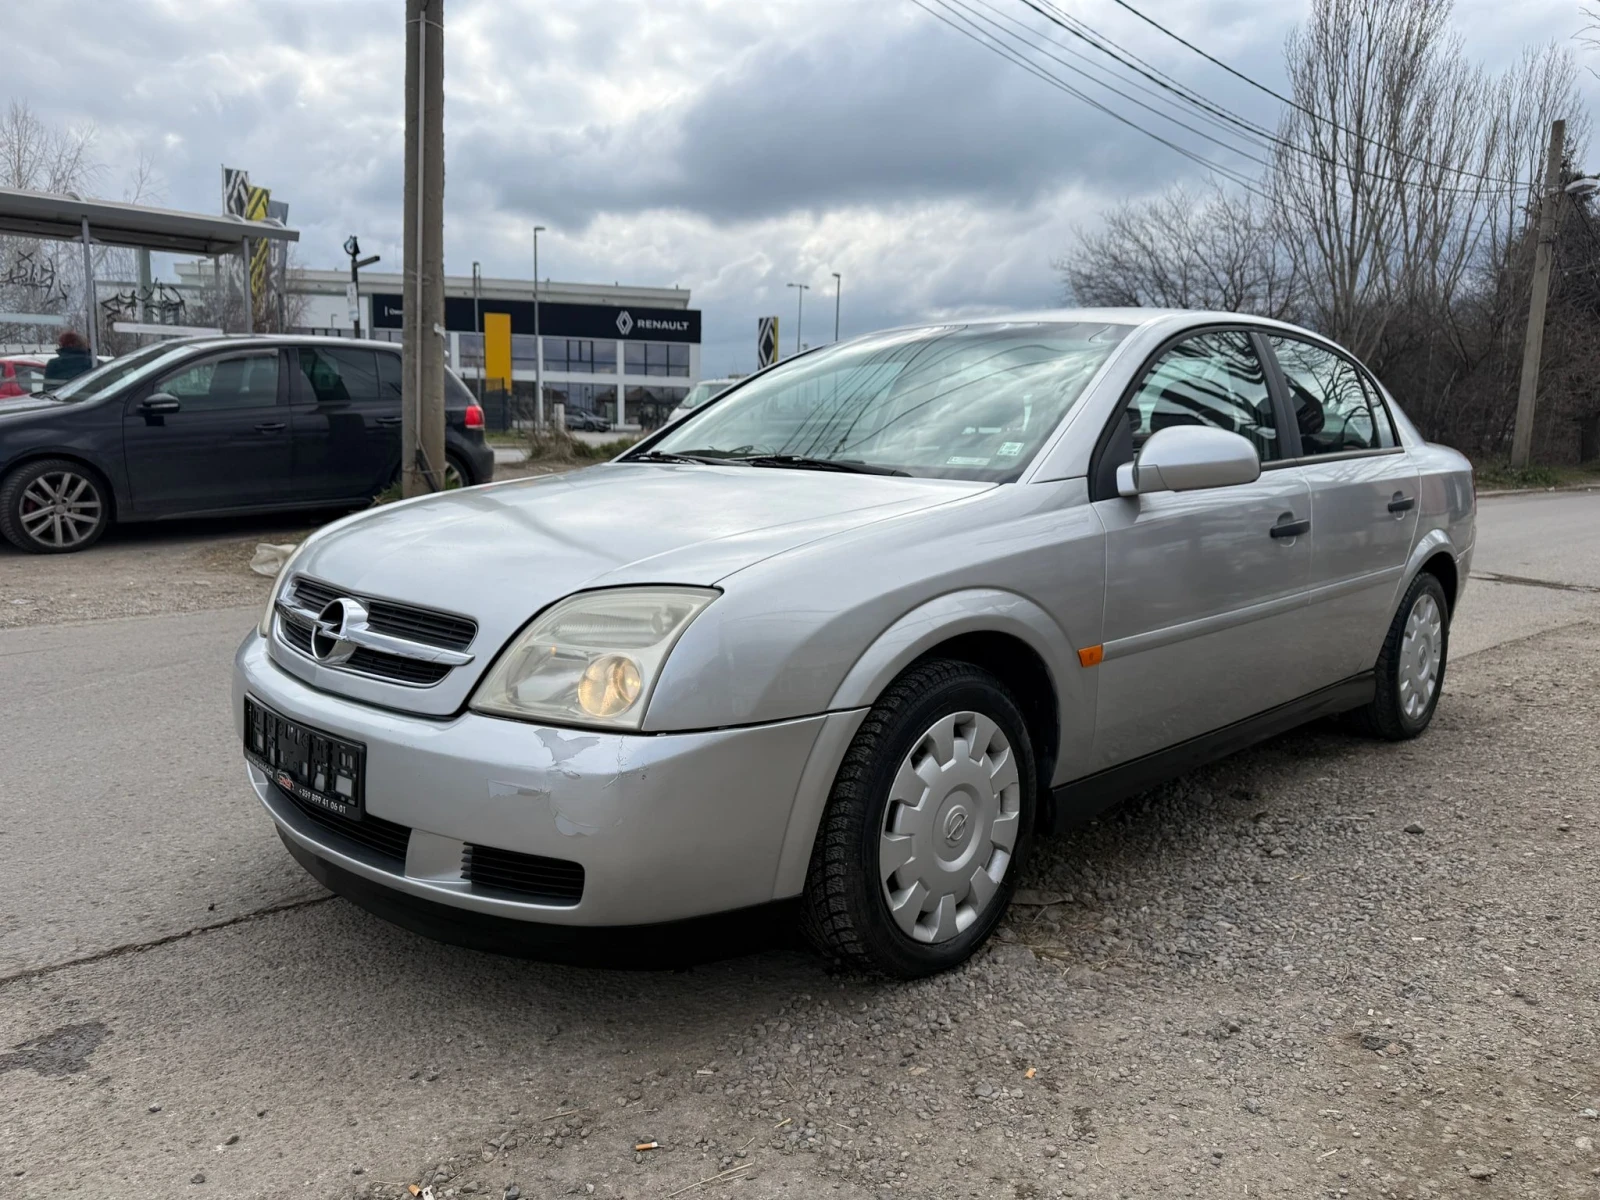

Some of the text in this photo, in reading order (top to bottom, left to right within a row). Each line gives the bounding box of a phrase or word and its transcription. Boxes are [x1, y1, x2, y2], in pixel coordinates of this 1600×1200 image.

[637, 319, 690, 331] RENAULT
[298, 788, 346, 814] +359 899 41 06 01
